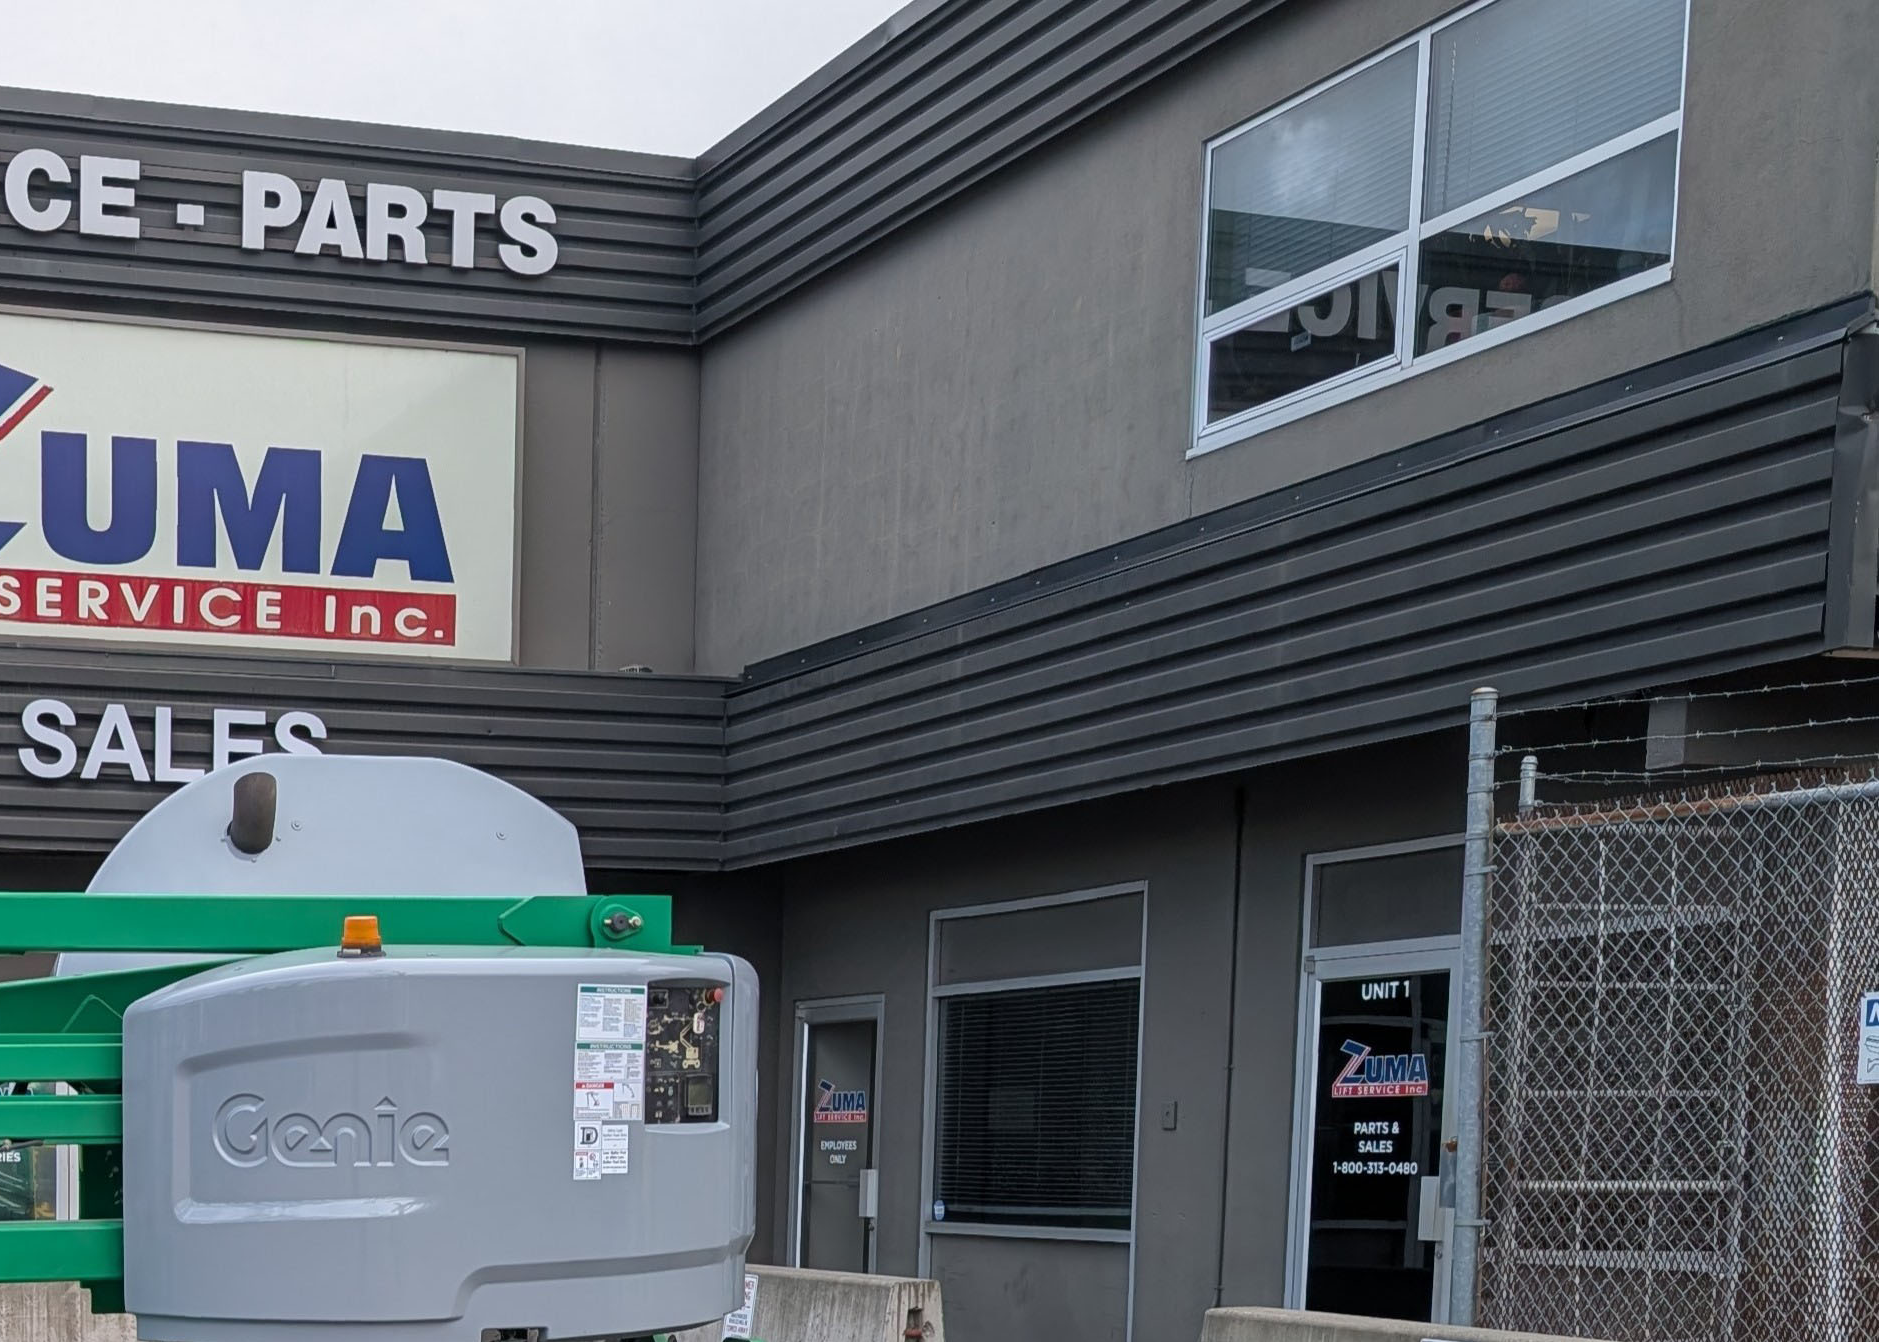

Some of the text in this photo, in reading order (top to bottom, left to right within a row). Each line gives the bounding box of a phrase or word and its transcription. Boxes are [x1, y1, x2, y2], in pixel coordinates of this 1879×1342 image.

[241, 170, 559, 275] PARTS
[324, 595, 444, 639] Inc.
[18, 698, 328, 783] SALES
[1361, 981, 1410, 1000] UNIT 1
[1333, 1039, 1429, 1086] ZUMA
[815, 1079, 867, 1112] ZUMA
[1334, 1083, 1426, 1096] LIFT SERVICE Inc.
[212, 1092, 450, 1168] Genie
[1354, 1121, 1401, 1135] PARTS &
[820, 1140, 858, 1151] EMPLOYEES
[1357, 1140, 1394, 1153] SALES
[829, 1154, 847, 1165] ONLY
[1332, 1161, 1418, 1175] 1-800-313-0480
